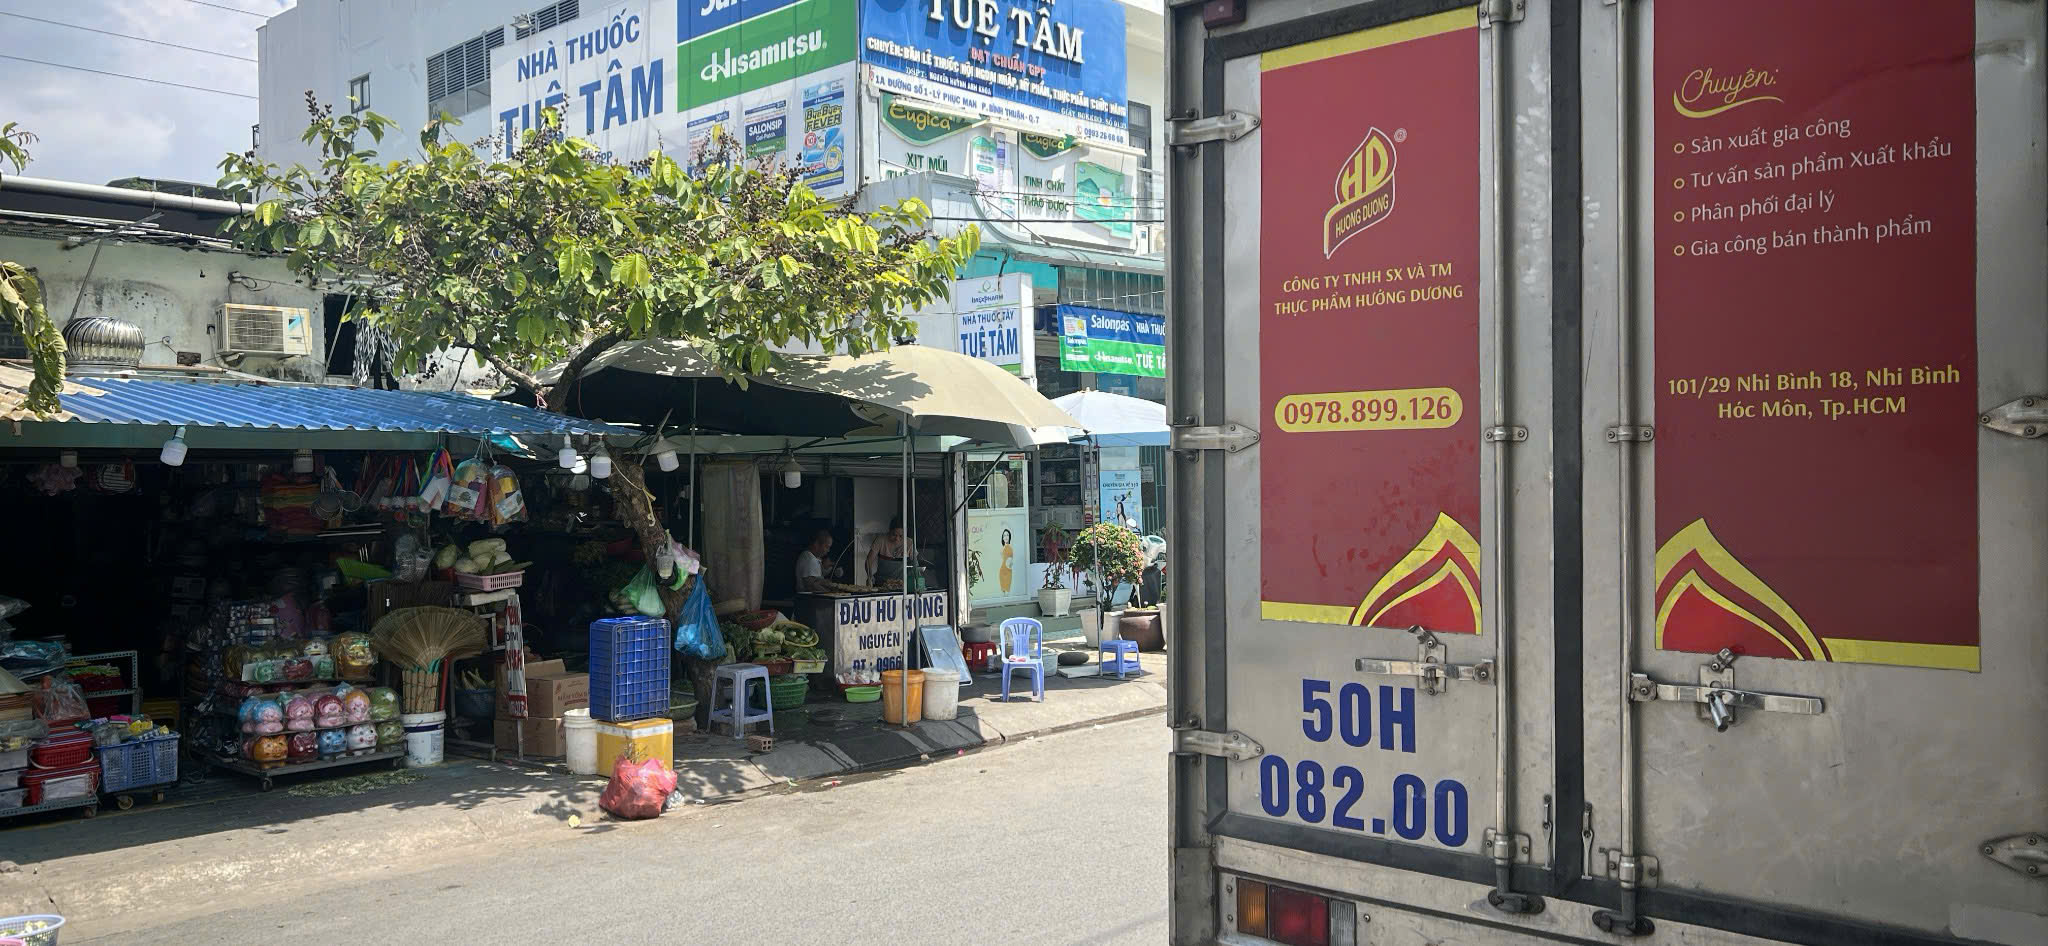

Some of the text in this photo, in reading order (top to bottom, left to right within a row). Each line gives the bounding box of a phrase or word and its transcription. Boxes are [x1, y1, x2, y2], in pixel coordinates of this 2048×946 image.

[518, 8, 640, 82] NHÀ THUỐC
[1010, 7, 1085, 64] TÂM
[701, 29, 823, 82] Hisamitsu
[580, 58, 663, 135] TÂM
[1681, 68, 1779, 104] Chuyên:
[748, 119, 783, 137] SALONSIP
[805, 115, 842, 132] FEVER
[889, 103, 952, 131] Eugica
[1691, 118, 1851, 154] Sản xuất gia công
[1342, 135, 1388, 201] HD
[1690, 136, 1952, 188] Tư vấn sản phẩm Xuất khẩu
[1024, 175, 1043, 189] TINH
[1691, 189, 1836, 222] Phân phối đại lý
[1691, 213, 1932, 256] Gia công bán thành phẩm
[1283, 262, 1452, 293] CÔNG TY TNHH SX VÀ TM
[1274, 284, 1463, 317] THỰC PHẨM HƯỚNG DƯƠNG
[962, 312, 977, 326] NHÀ
[1091, 314, 1130, 333] Salonpas
[1136, 320, 1149, 335] NHÀ
[988, 324, 1019, 357] TÂM
[1136, 350, 1153, 373] TUỆ
[1668, 364, 1961, 399] 101/29 Nhi Bình 18, Nhi Bình
[1283, 394, 1452, 425] 0978.899.126
[1718, 396, 1907, 421] Hóc Môn, Tp.HCM
[840, 598, 871, 628] ĐẬU
[1302, 678, 1416, 754] 50H
[1260, 754, 1469, 848] 082.00
